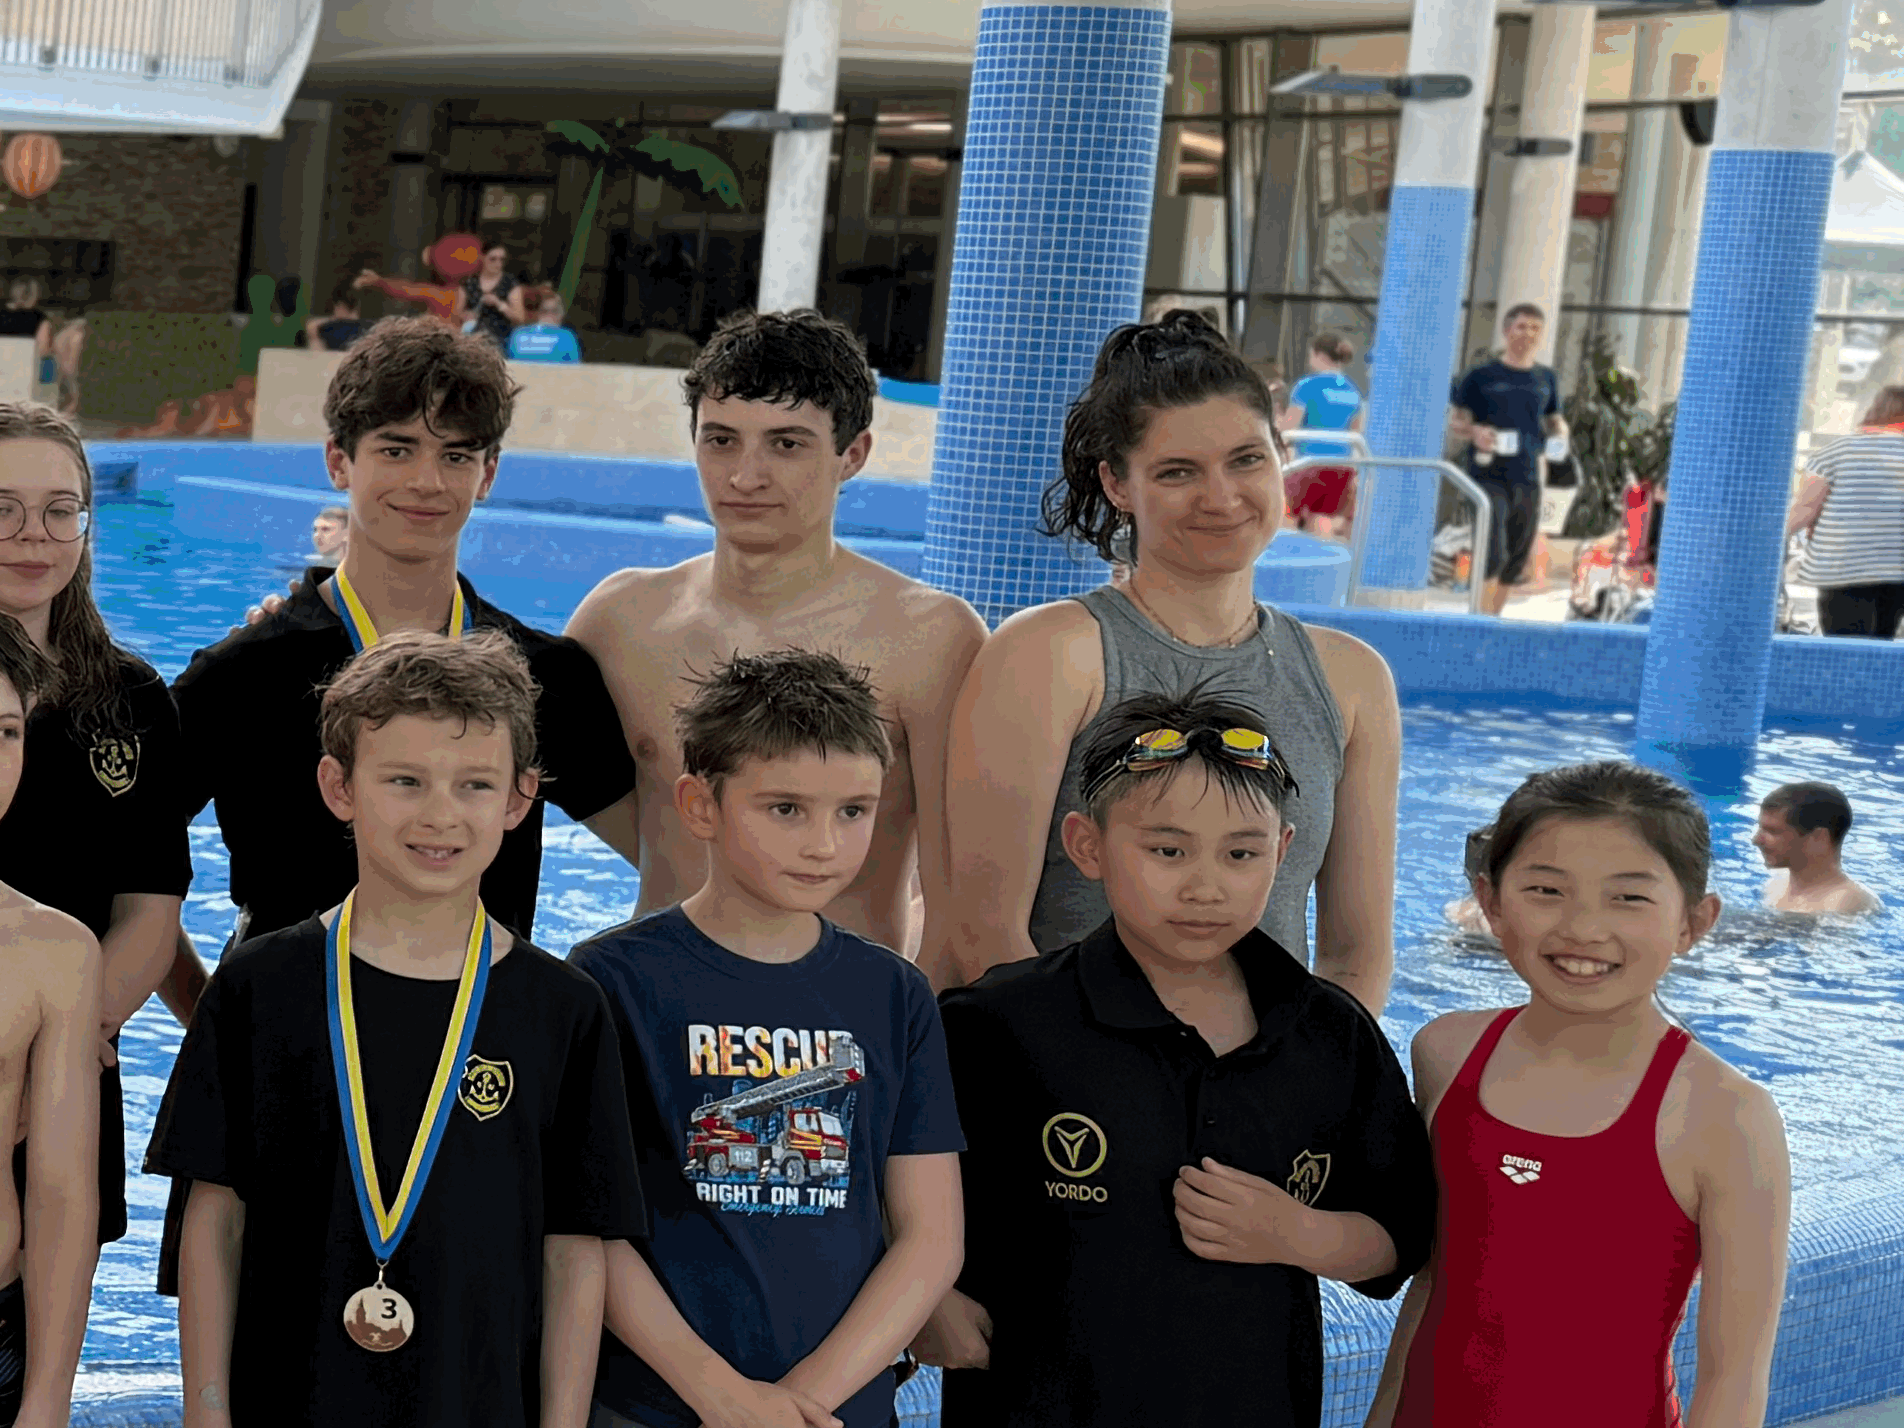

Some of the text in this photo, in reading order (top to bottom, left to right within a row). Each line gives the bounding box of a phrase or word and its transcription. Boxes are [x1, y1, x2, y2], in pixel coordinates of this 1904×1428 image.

[734, 1149, 752, 1163] 112
[1502, 1153, 1543, 1172] arena
[695, 1181, 848, 1209] RIGHT ON TIME
[1044, 1180, 1109, 1203] YORDO
[380, 1297, 397, 1320] 3
